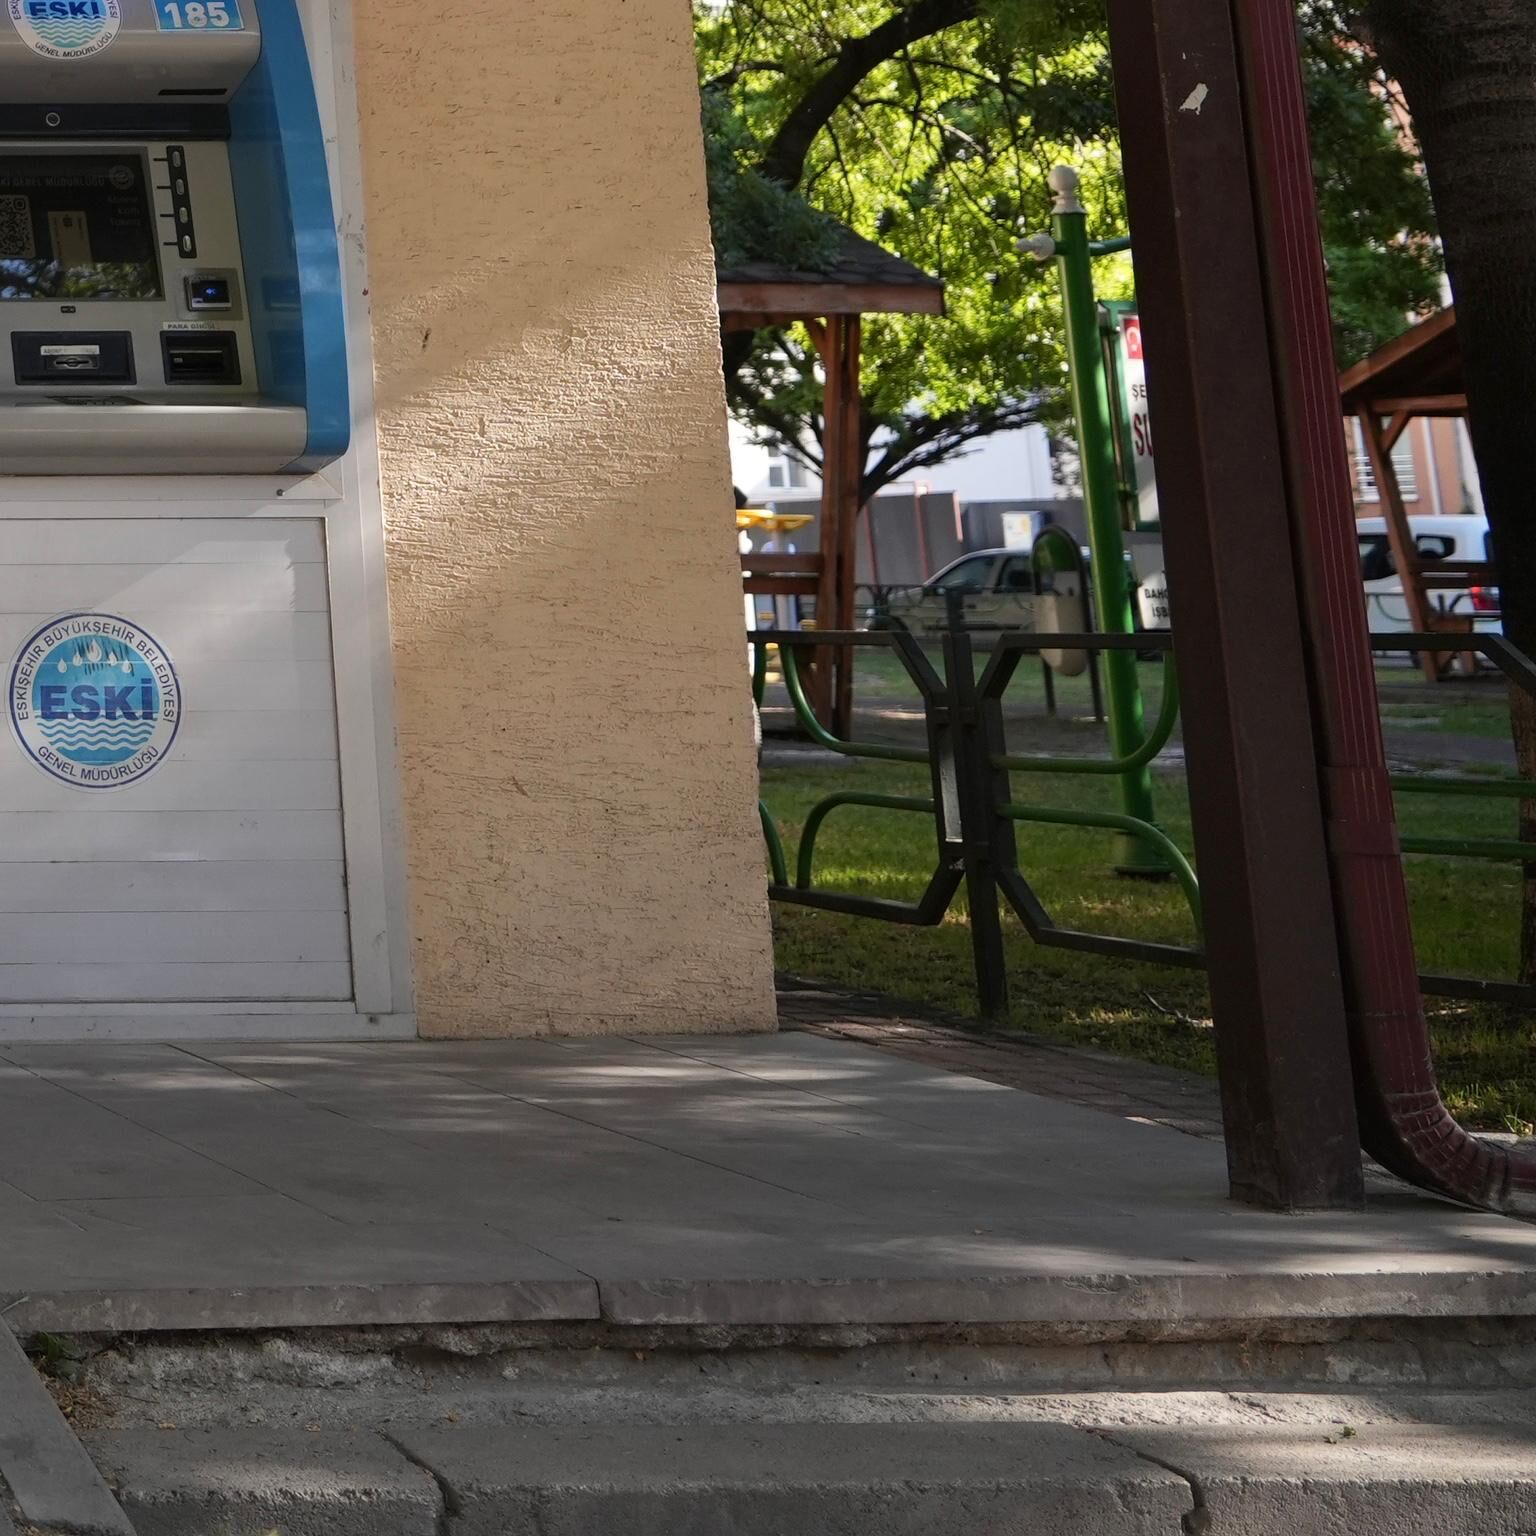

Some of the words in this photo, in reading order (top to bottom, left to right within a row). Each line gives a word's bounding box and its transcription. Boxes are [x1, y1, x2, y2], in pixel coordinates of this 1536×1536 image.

[164, 1, 230, 29] 185
[35, 41, 60, 57] GENEL
[16, 644, 46, 721] ESKİŞEHİR
[44, 620, 136, 648] BÜYÜKŞEHİR
[136, 639, 177, 724] BELEDİYESİ
[39, 677, 154, 721] ESKİ
[37, 745, 79, 778] GENEL
[80, 745, 160, 782] MÜDÜRLÜĞÜ
